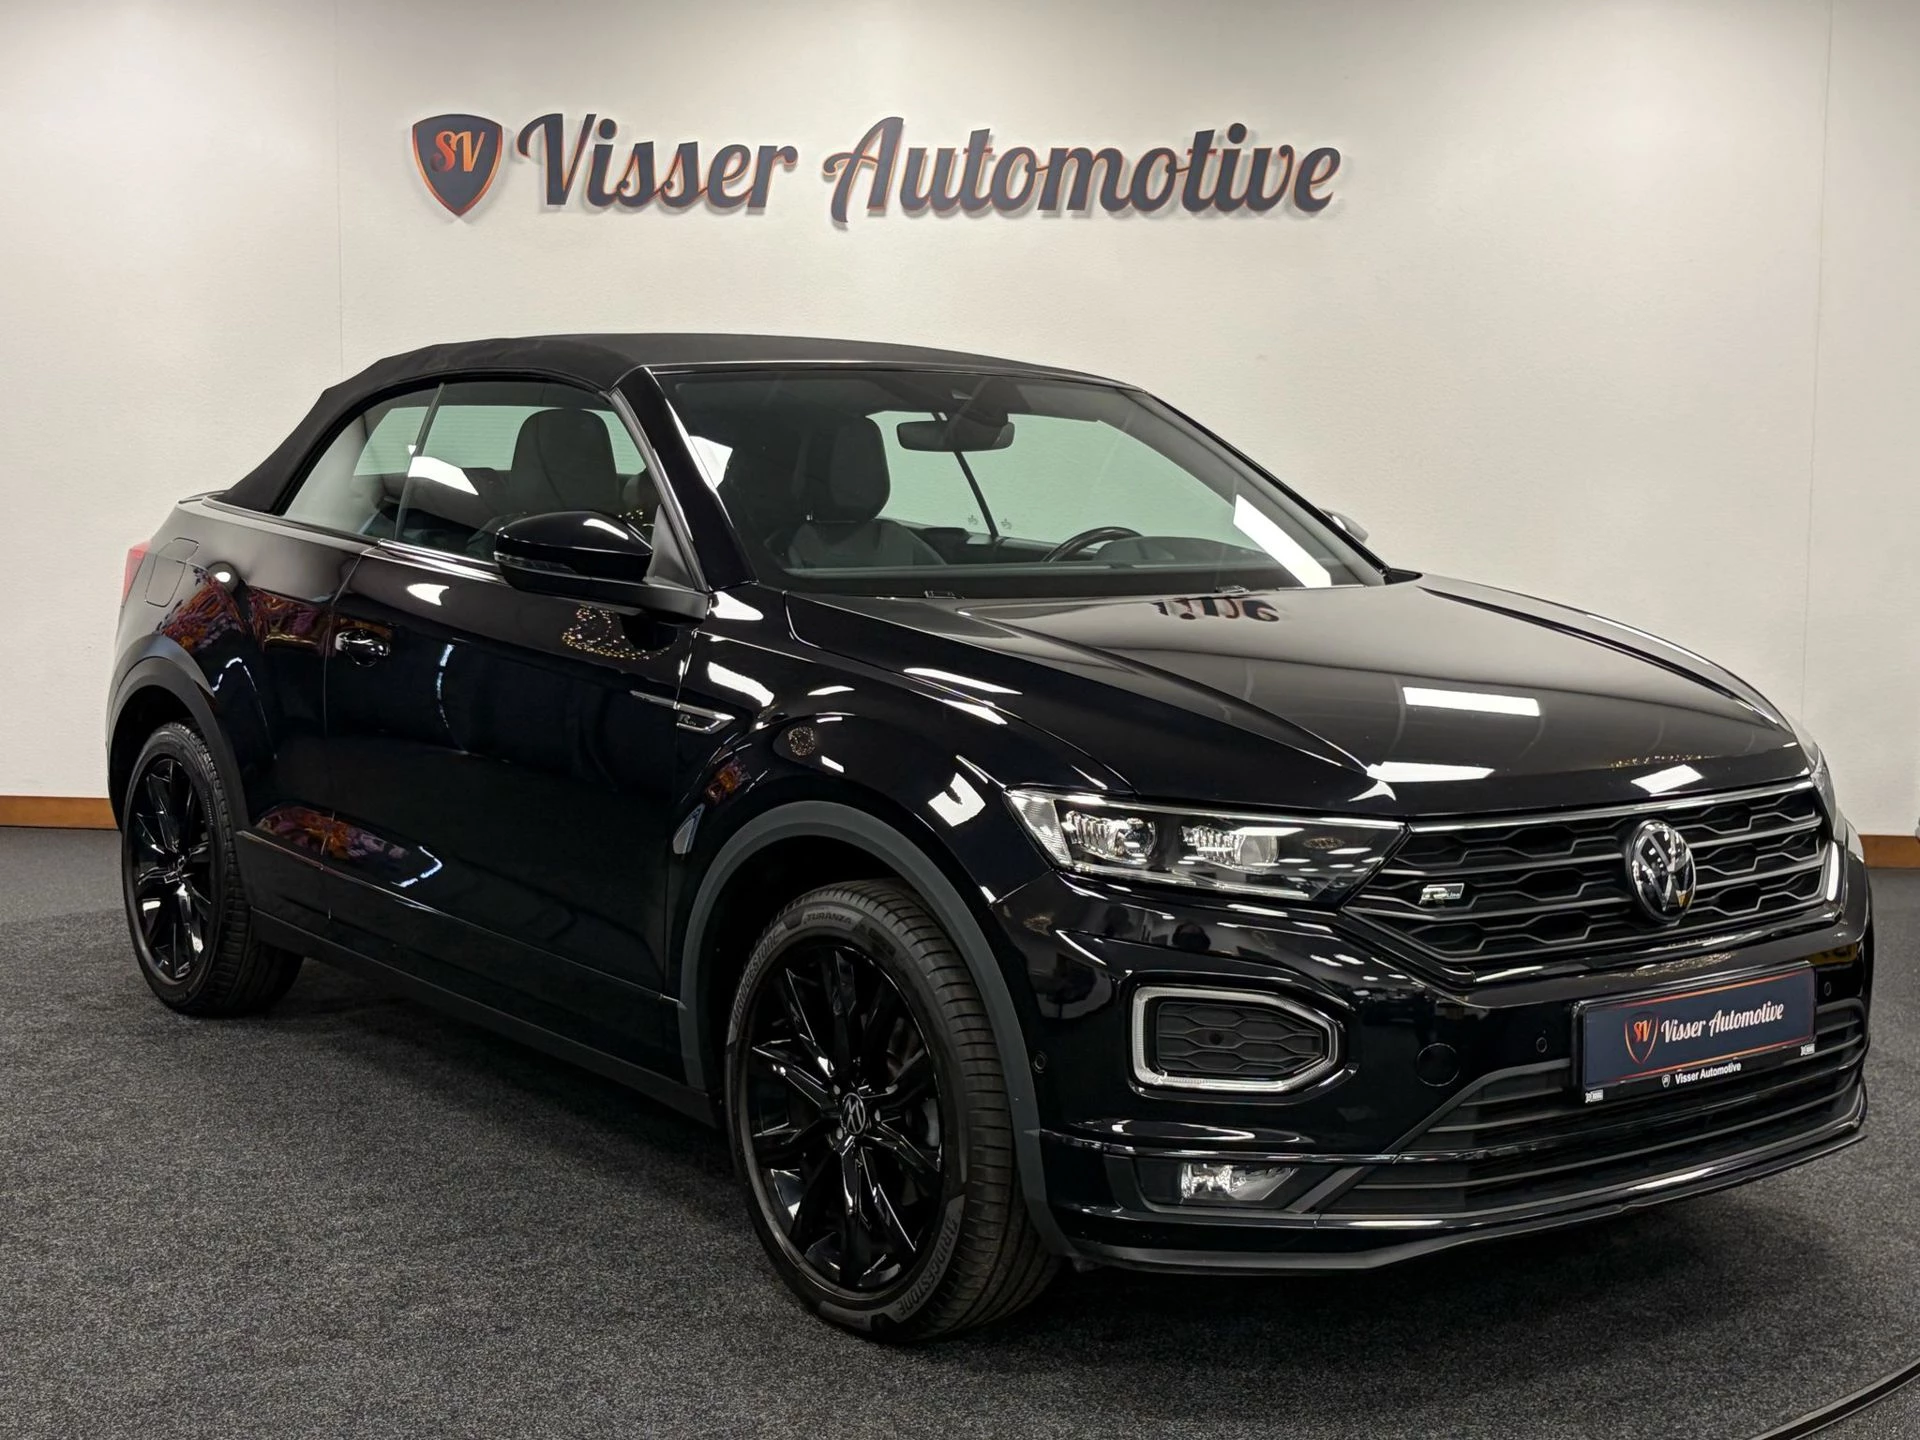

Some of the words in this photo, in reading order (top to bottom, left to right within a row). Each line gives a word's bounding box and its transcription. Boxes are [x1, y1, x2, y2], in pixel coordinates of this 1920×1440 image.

[431, 130, 485, 172] SV
[517, 113, 798, 208] Visser
[823, 116, 1340, 223] Automotive
[804, 912, 852, 925] TURANZA
[1661, 1018, 1705, 1043] Visser
[1709, 1001, 1785, 1038] Automotive
[1675, 1071, 1699, 1085] Visser
[1700, 1062, 1742, 1080] Automotive
